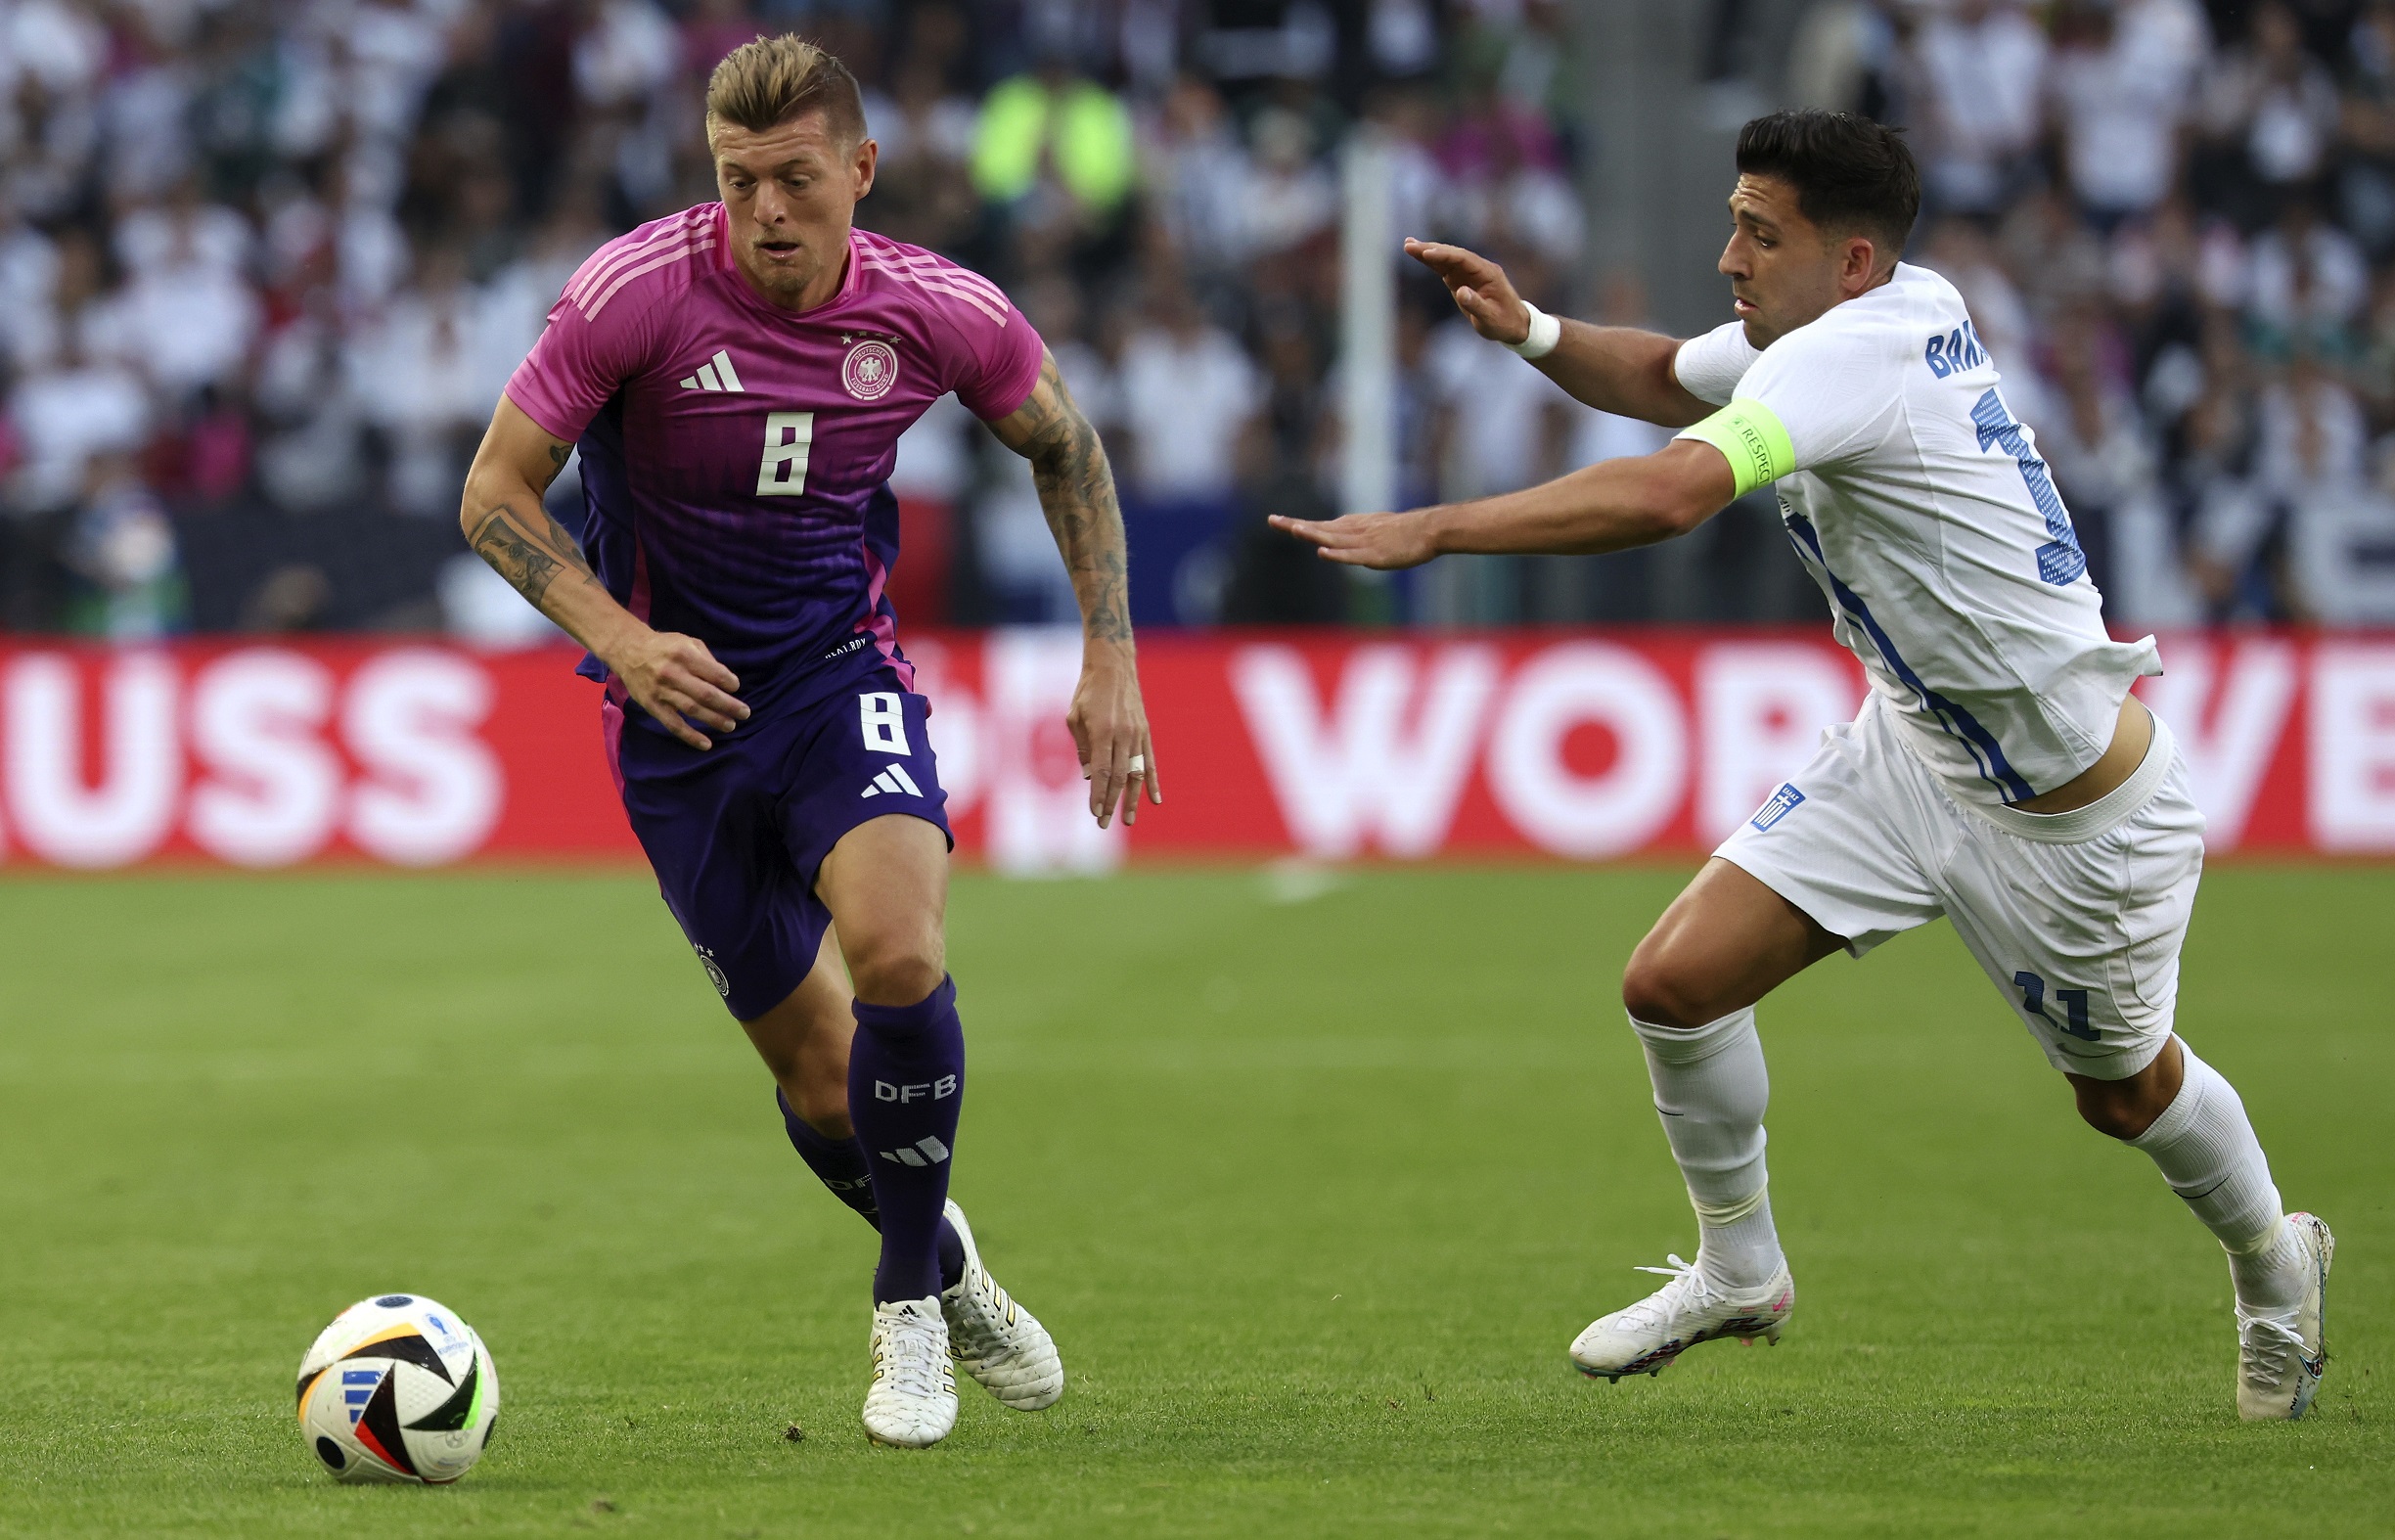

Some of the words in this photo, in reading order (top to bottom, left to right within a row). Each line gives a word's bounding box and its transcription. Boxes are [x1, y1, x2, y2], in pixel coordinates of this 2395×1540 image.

[854, 347, 887, 361] DEUTSCHER
[755, 412, 814, 496] 8
[1741, 428, 1772, 484] RESPECT
[859, 692, 911, 756] 8
[875, 1073, 957, 1104] DFB
